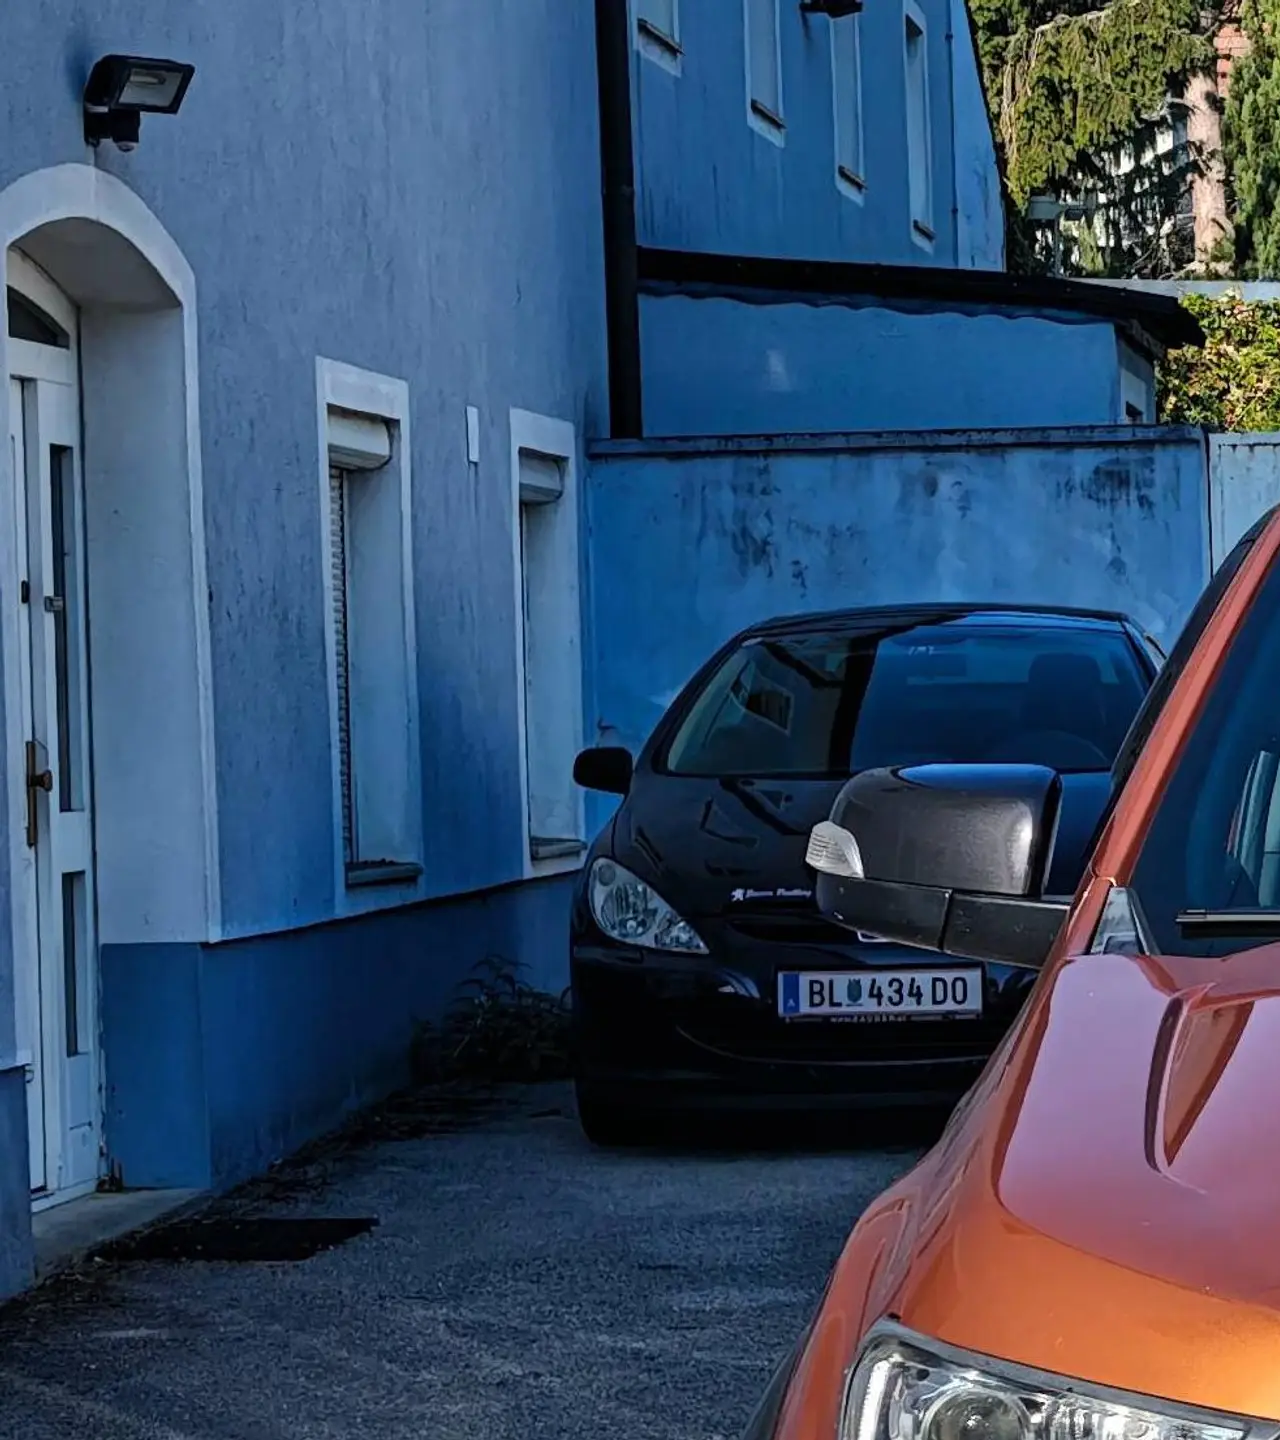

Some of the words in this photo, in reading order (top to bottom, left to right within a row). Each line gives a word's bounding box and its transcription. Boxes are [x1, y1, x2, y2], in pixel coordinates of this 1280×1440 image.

[809, 979, 843, 1007] BL
[868, 976, 924, 1007] 434
[931, 976, 968, 1005] DO
